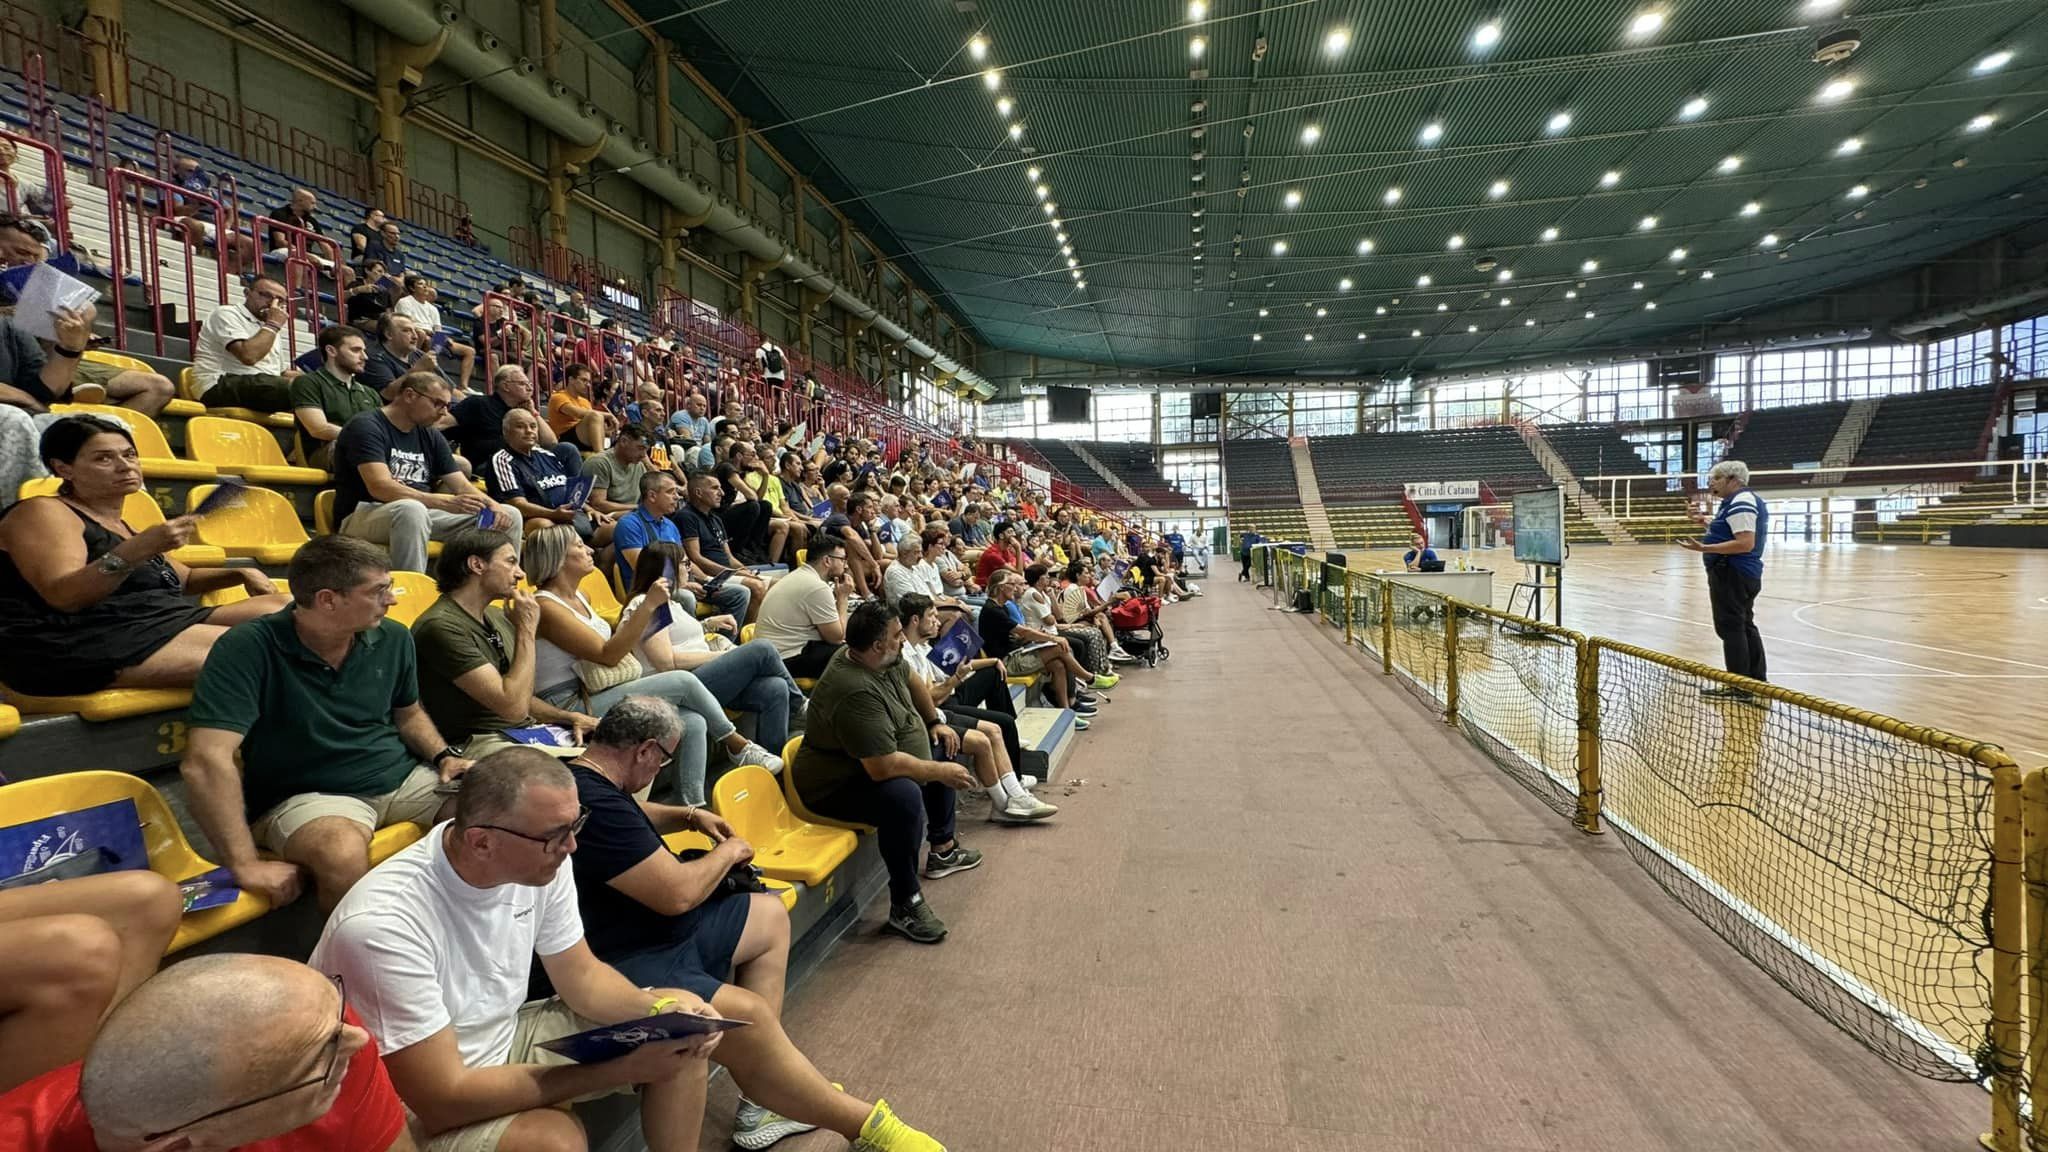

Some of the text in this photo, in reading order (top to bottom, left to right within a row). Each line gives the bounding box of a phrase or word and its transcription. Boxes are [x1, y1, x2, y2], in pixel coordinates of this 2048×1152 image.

[154, 487, 175, 509] 5
[1439, 484, 1446, 496] di
[1447, 485, 1477, 496] Catania
[157, 720, 185, 753] 3
